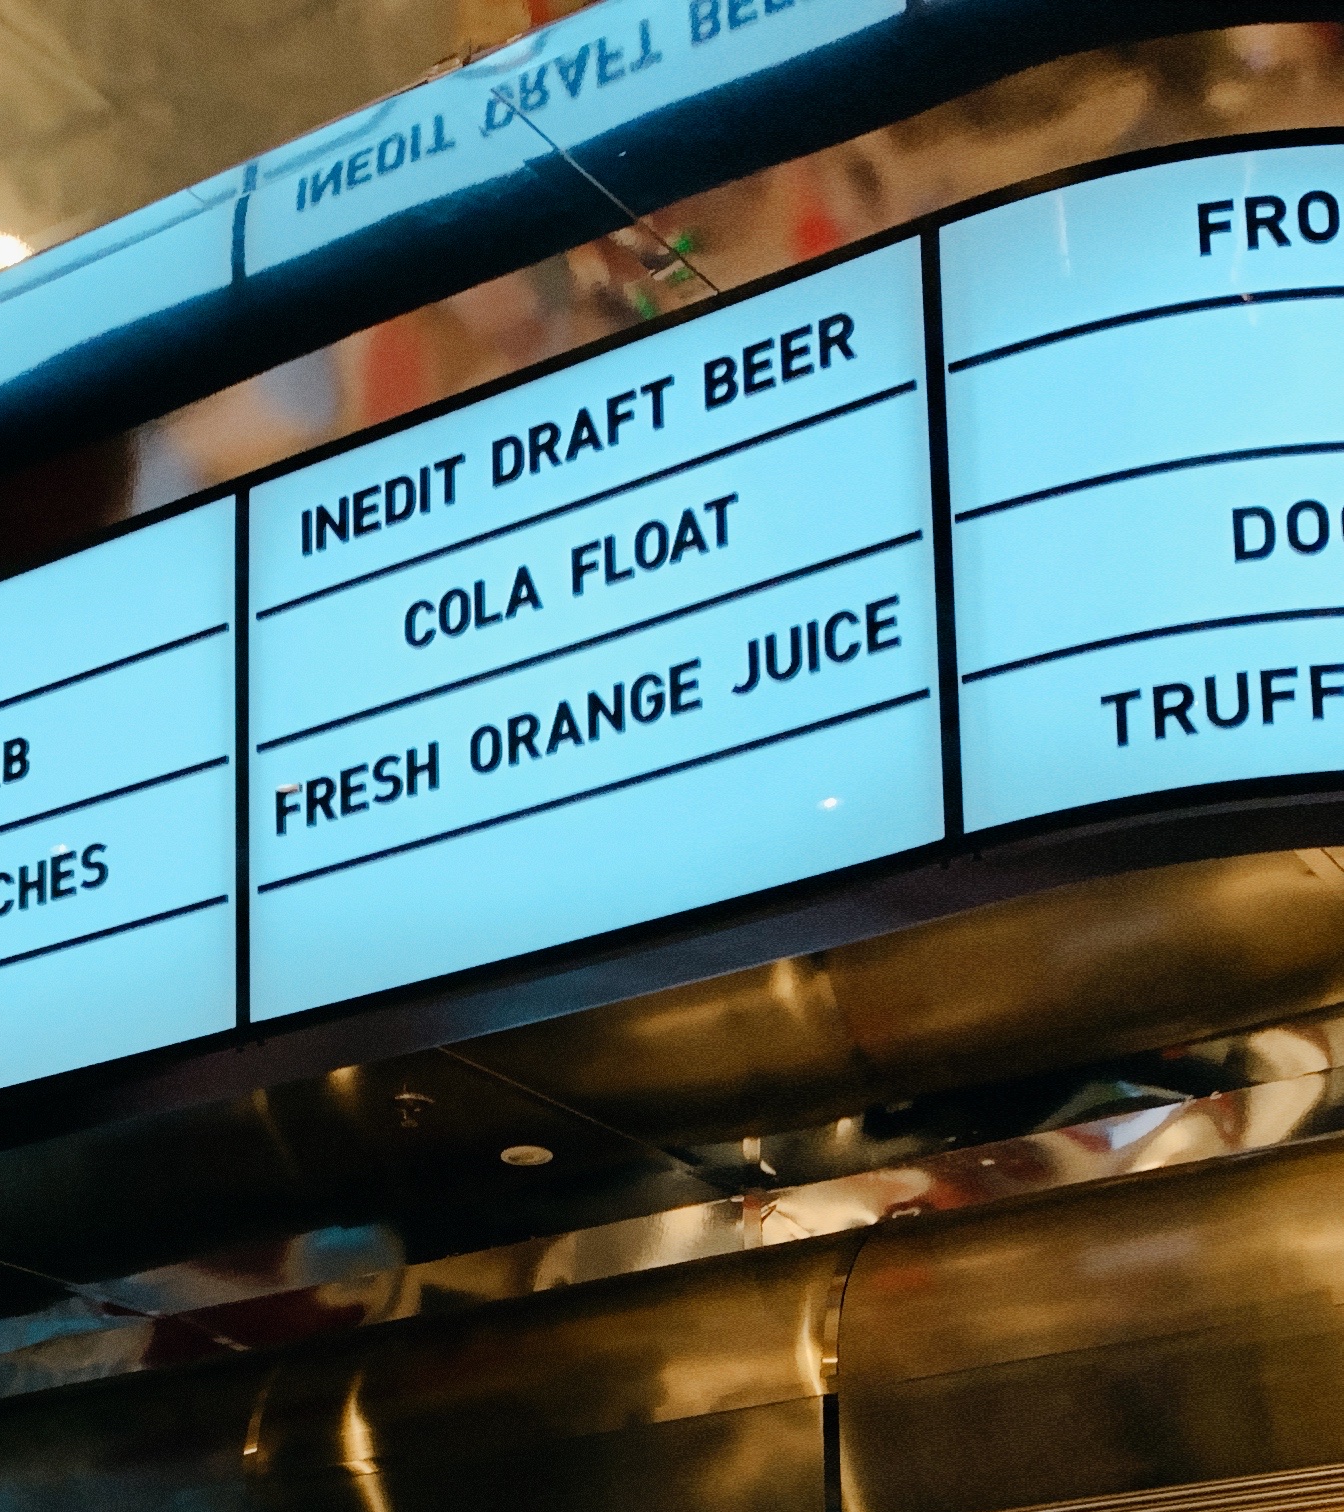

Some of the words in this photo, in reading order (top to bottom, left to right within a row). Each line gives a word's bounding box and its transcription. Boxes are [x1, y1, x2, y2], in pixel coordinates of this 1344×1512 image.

[301, 453, 466, 556] INEDIT
[491, 375, 674, 488] DRAFT
[703, 312, 856, 411] BEER
[404, 565, 544, 649] COLA
[570, 493, 739, 598] FLOAT
[274, 741, 440, 836] FRESH
[469, 657, 703, 772] ORANGE
[731, 595, 902, 695] JUICE
